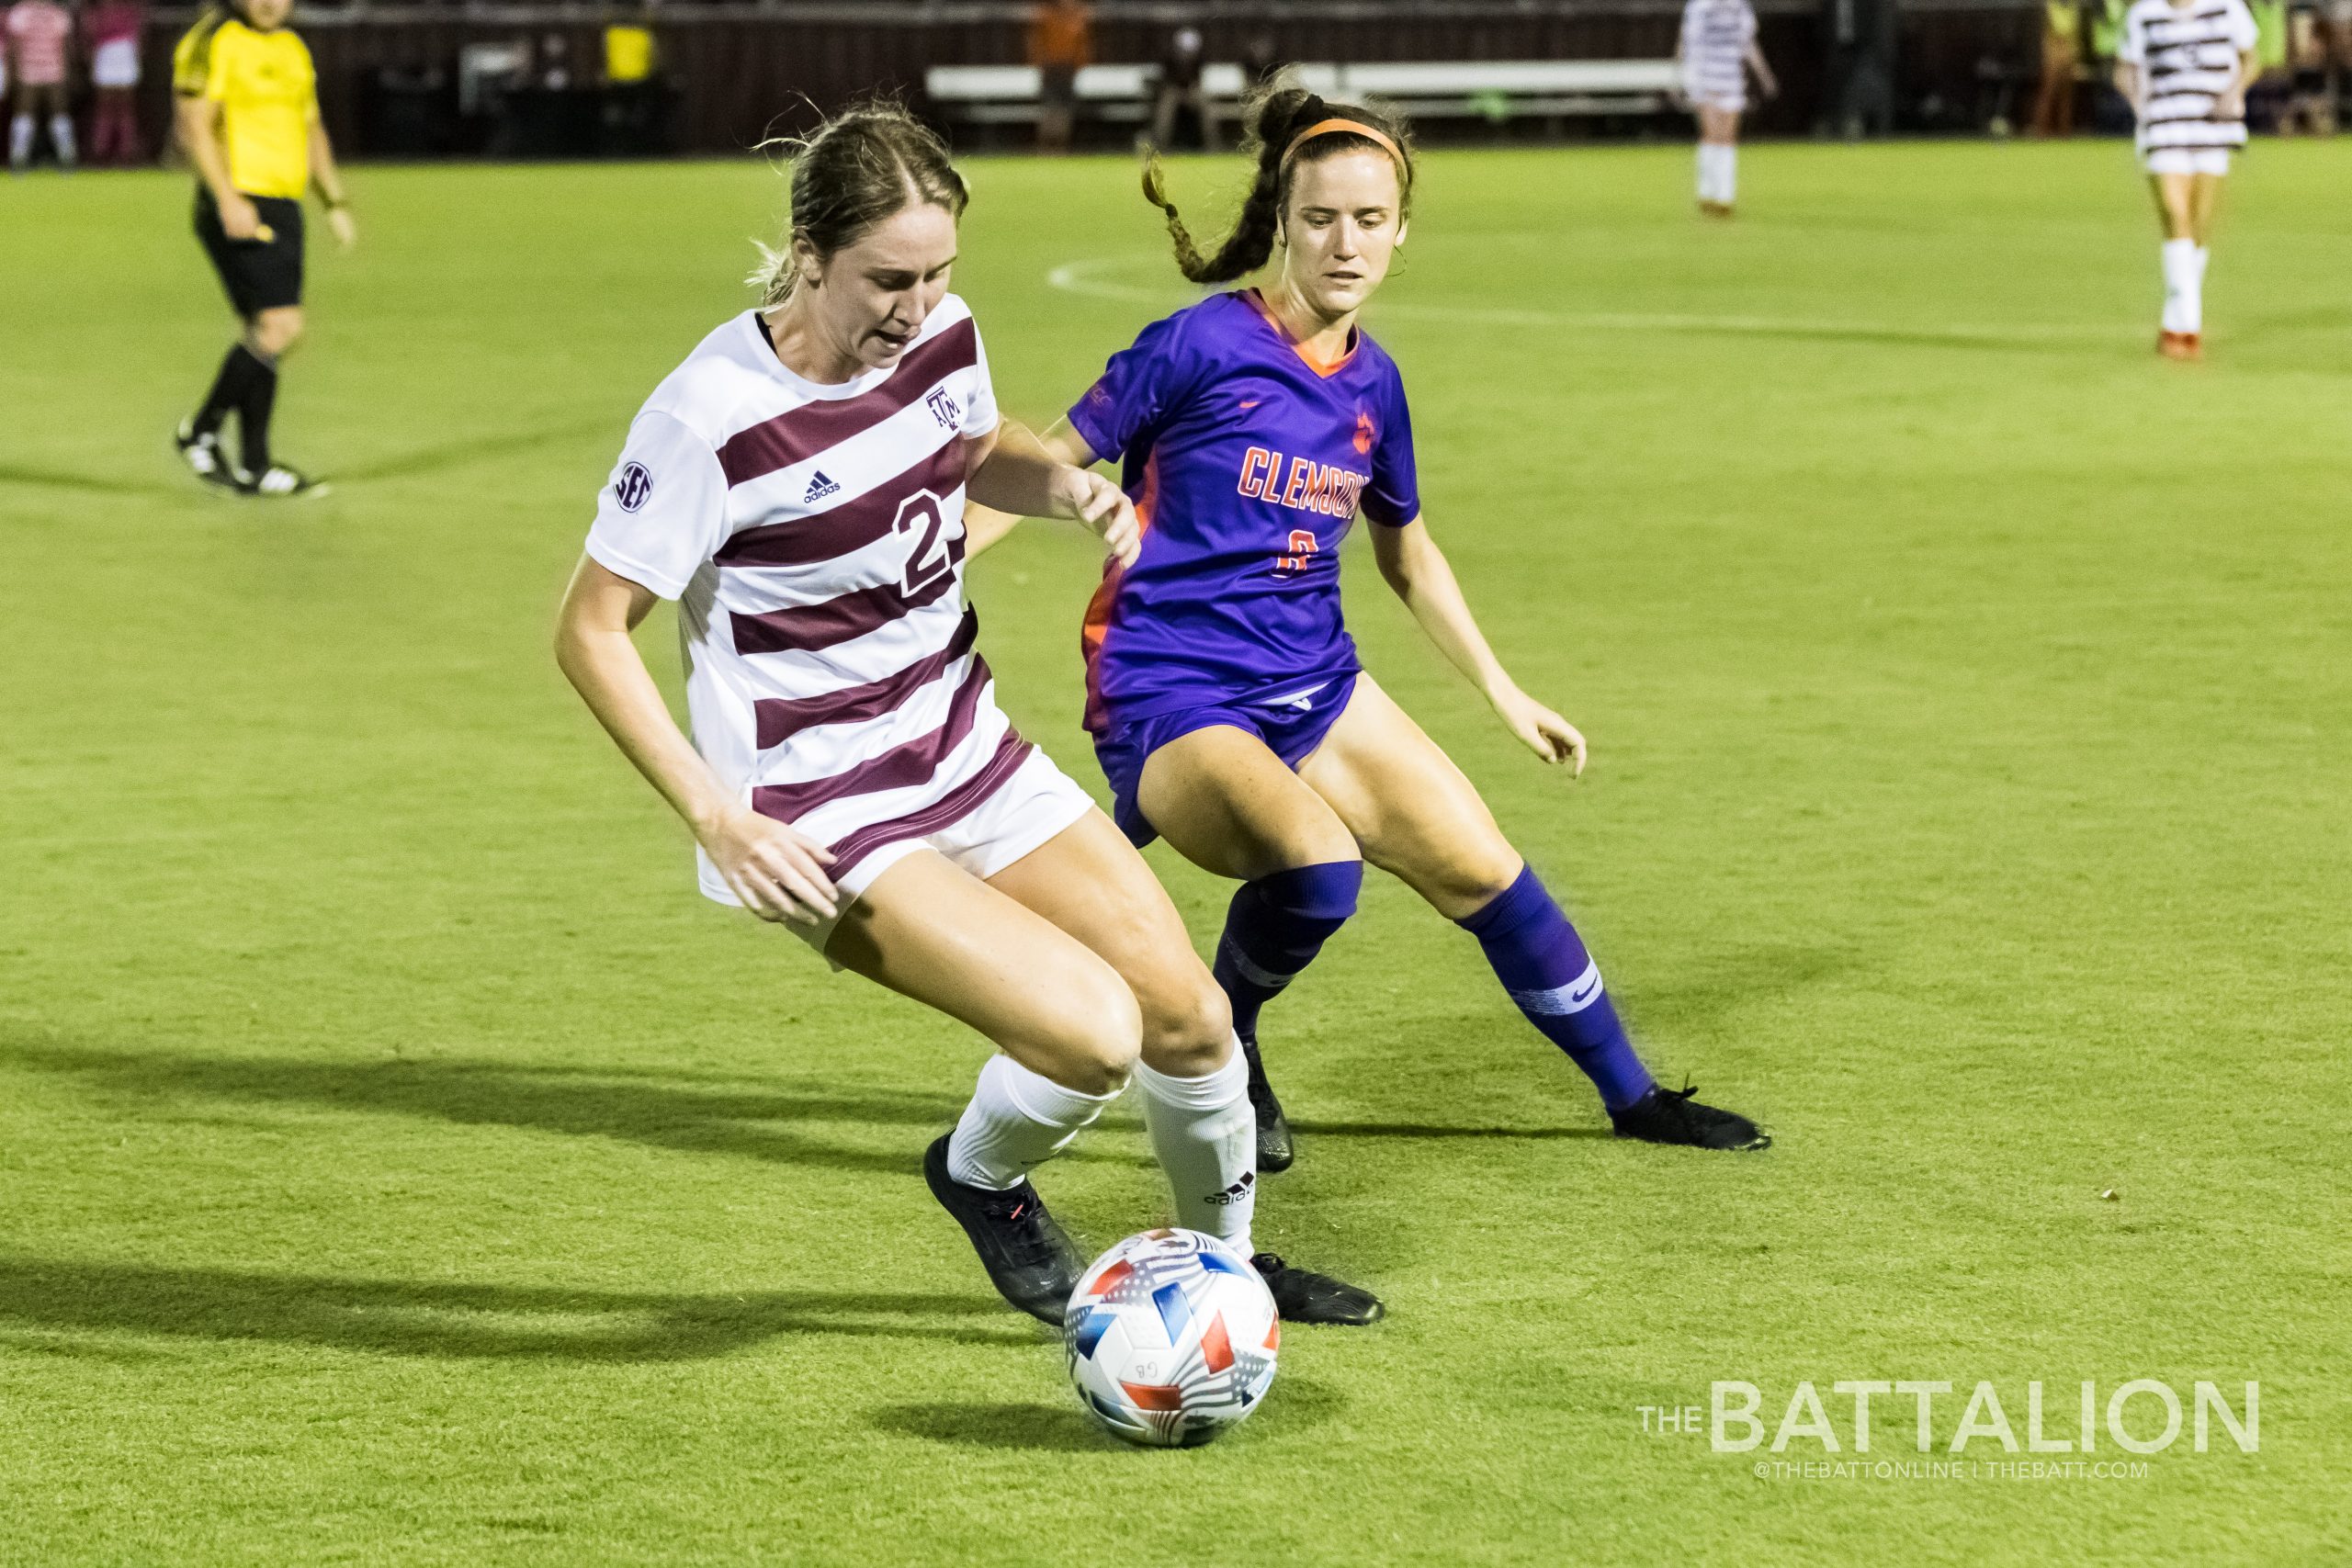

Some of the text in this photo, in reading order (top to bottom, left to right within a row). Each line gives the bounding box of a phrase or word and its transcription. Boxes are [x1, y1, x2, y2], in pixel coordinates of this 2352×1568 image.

[615, 464, 650, 509] SEC
[803, 482, 841, 504] adidas
[891, 487, 952, 599] 2
